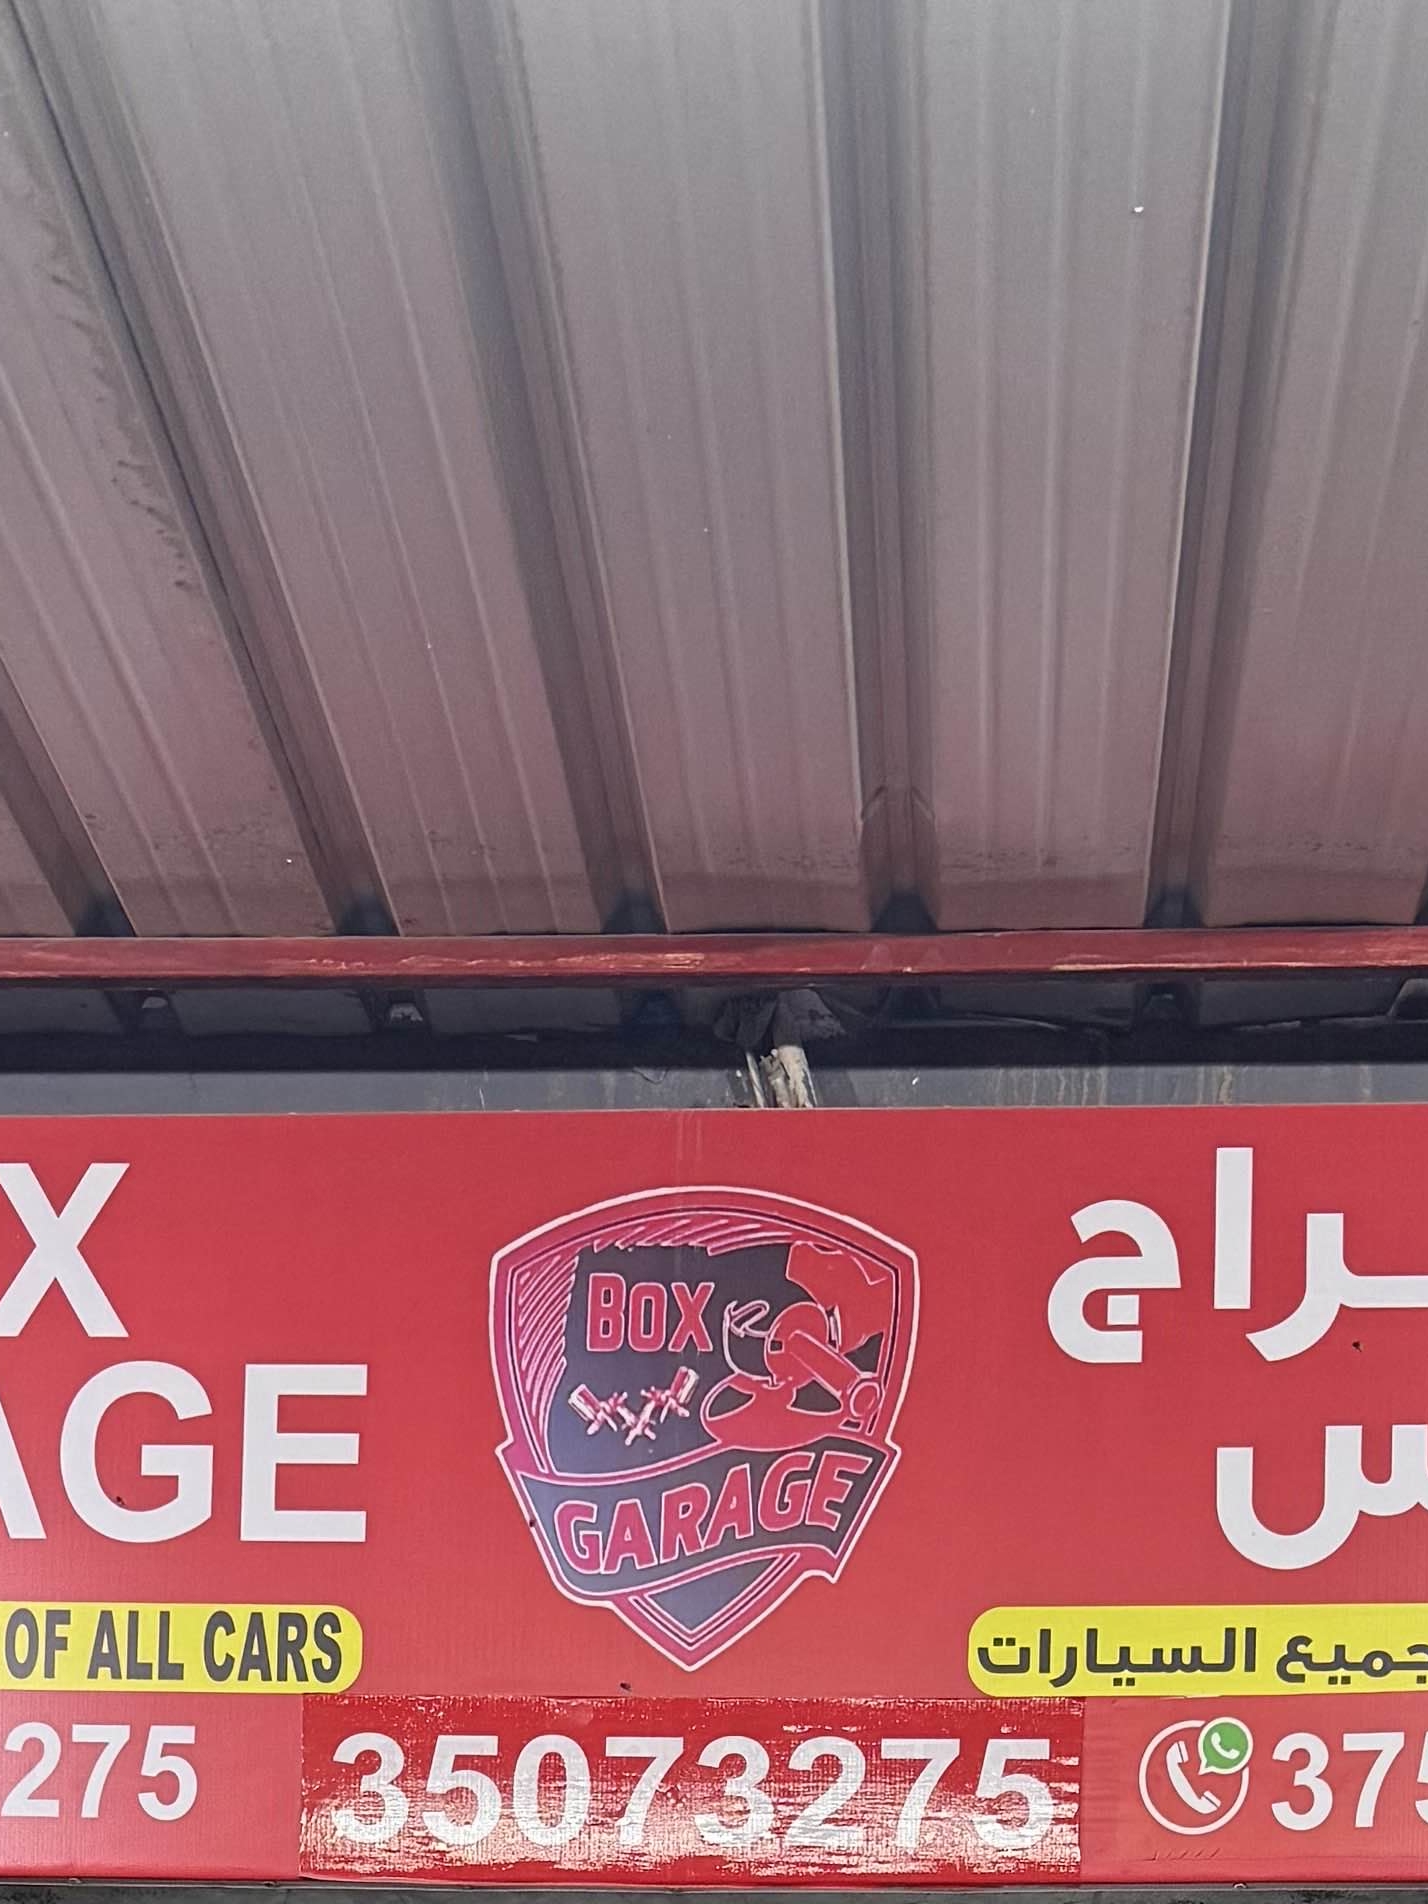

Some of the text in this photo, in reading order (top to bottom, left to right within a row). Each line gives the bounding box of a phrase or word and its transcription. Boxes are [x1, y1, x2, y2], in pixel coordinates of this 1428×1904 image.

[586, 1273, 715, 1352] BOX
[554, 1451, 872, 1575] GARAGE
[4, 1607, 71, 1680] OF
[86, 1610, 185, 1681] ALL
[203, 1610, 343, 1684] CARS
[977, 1627, 1257, 1688] السيارات
[331, 1733, 1054, 1850] 35073275
